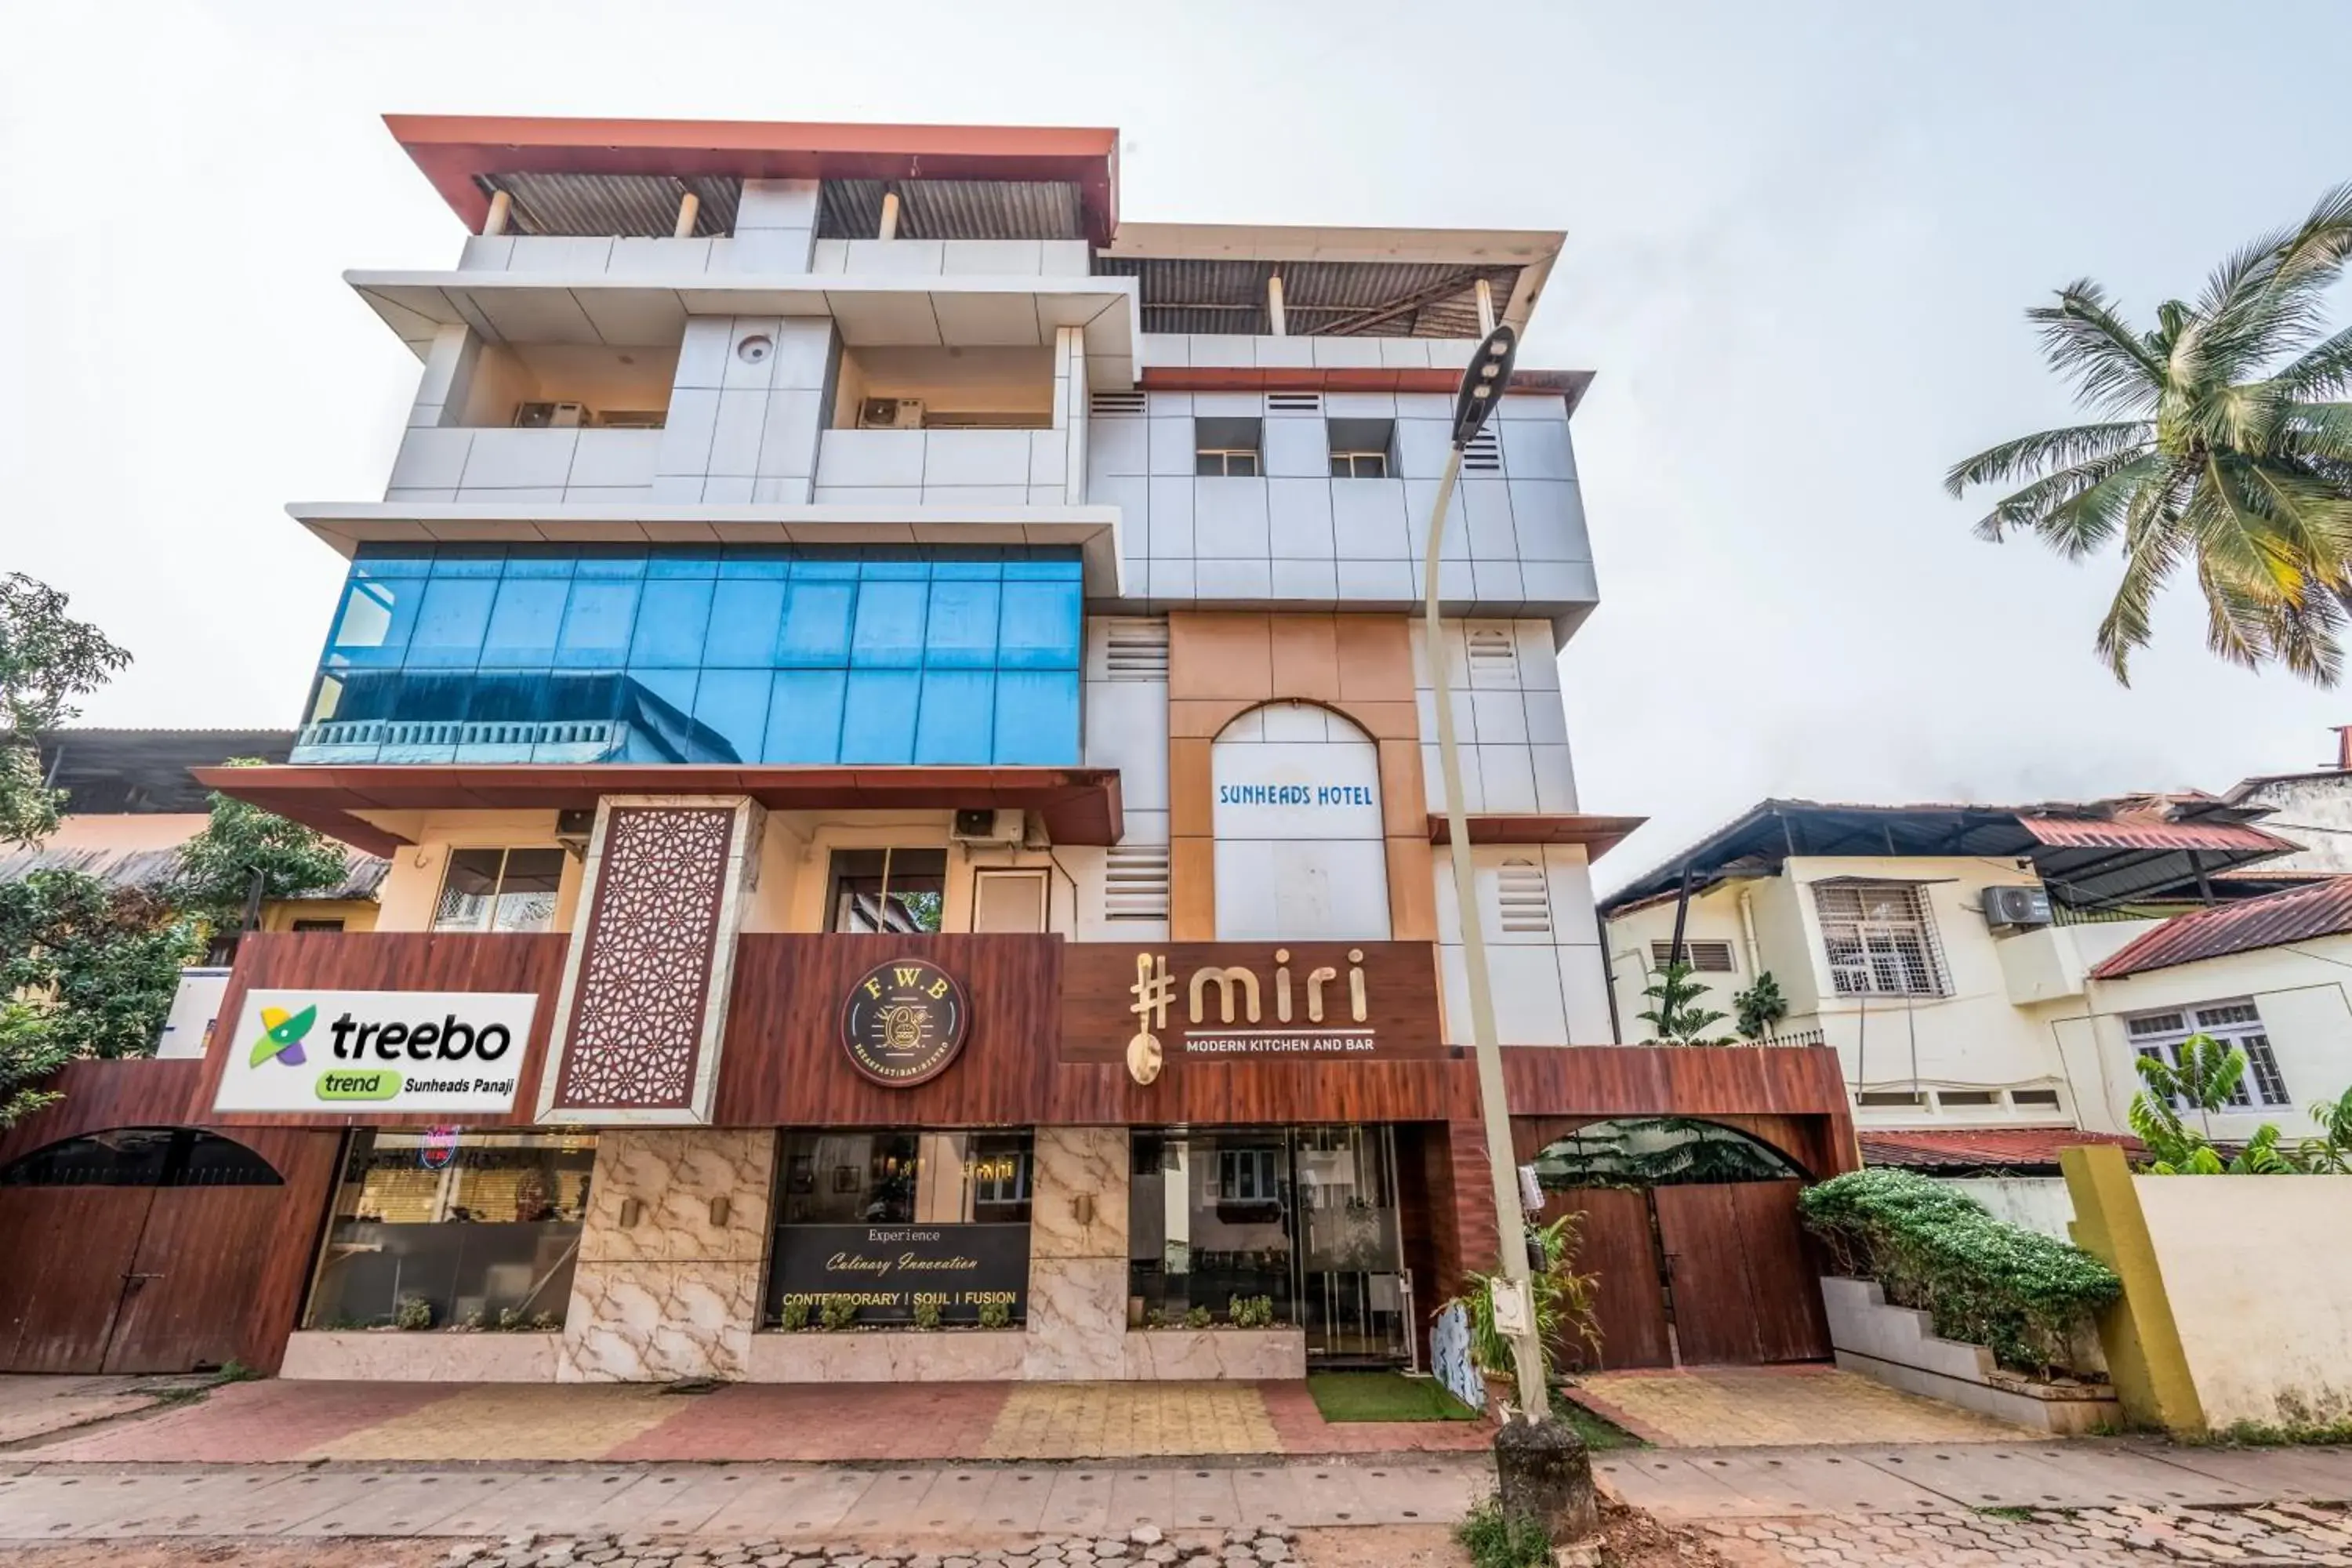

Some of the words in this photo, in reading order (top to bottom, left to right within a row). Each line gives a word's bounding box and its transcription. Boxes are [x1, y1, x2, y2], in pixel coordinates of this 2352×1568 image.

[1220, 785, 1311, 805] SUNHEADS
[1318, 786, 1373, 805] HOTEL
[330, 1012, 511, 1061] treebo
[1186, 1040, 1247, 1052] MODERN
[1250, 1039, 1310, 1051] KITCHEN
[1313, 1038, 1342, 1051] AND
[1346, 1038, 1374, 1051] BAR
[325, 1074, 380, 1093] trend
[404, 1078, 470, 1094] Sunheads
[472, 1078, 514, 1097] Panaji
[868, 1229, 941, 1243] Experience
[826, 1252, 893, 1277] Culinary
[897, 1252, 978, 1271] Innovation
[783, 1292, 901, 1305] CONTEORARY
[913, 1292, 951, 1305] SOUL
[964, 1291, 1017, 1305] FUSION
